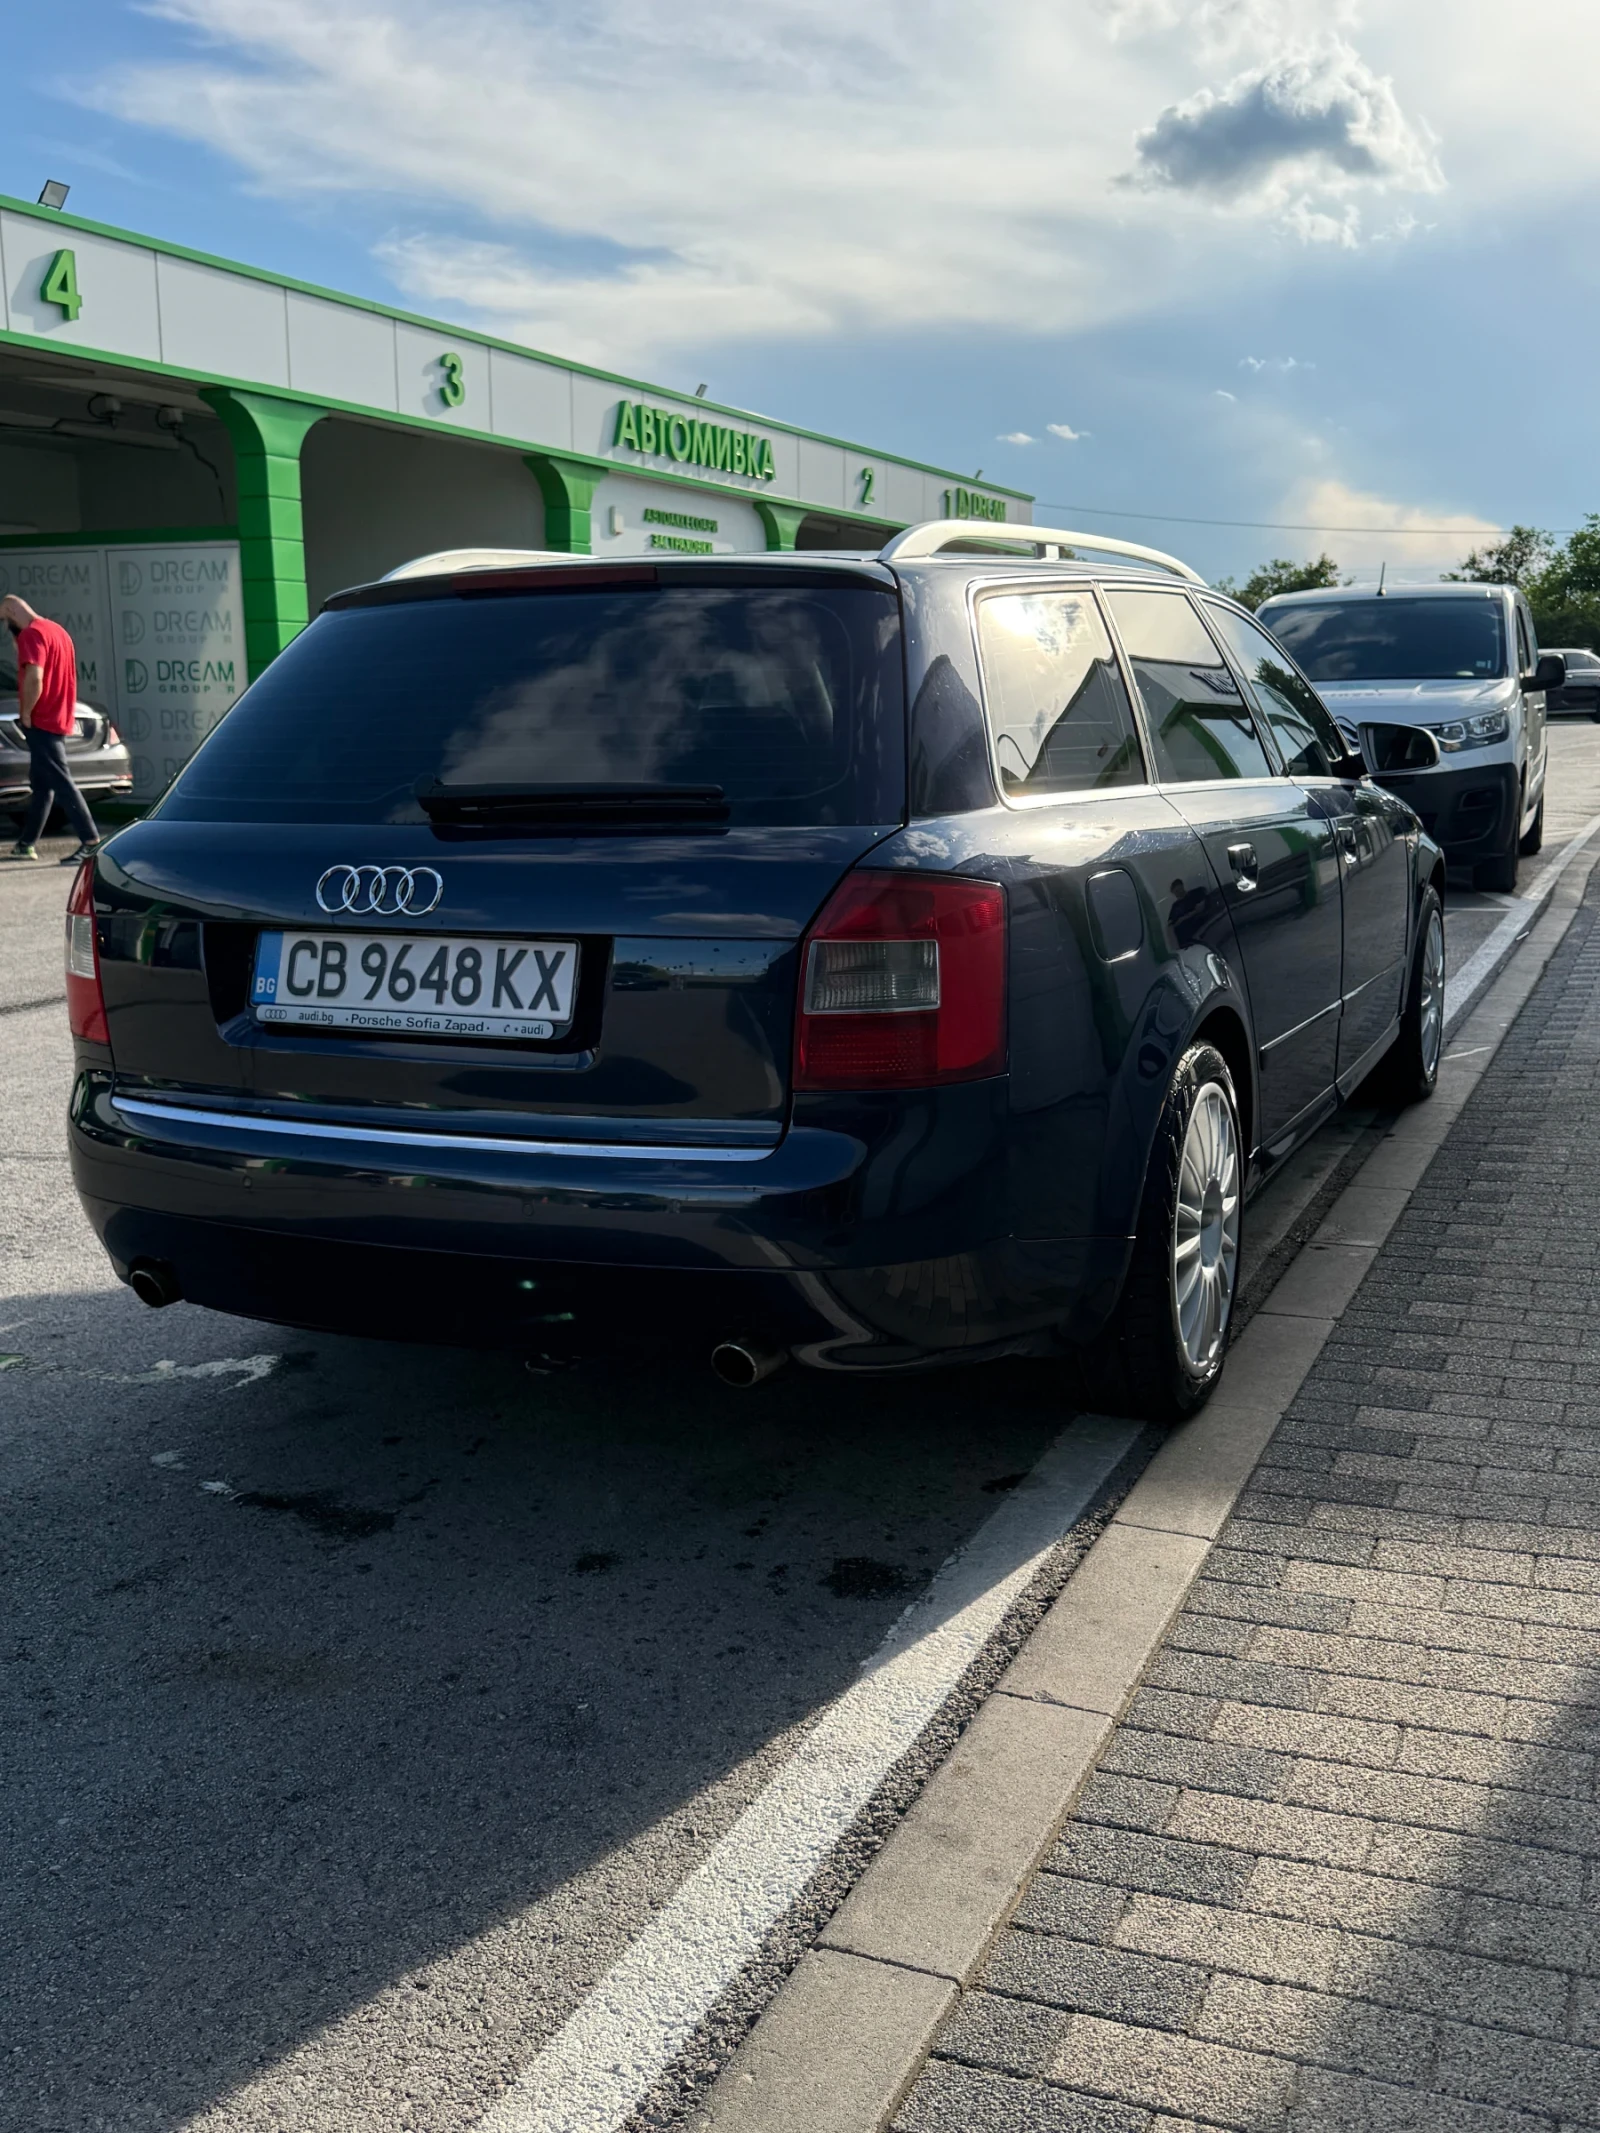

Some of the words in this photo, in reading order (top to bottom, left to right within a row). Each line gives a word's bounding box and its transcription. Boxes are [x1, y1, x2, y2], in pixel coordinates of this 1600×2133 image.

[40, 249, 83, 321] 4
[439, 352, 466, 407] 3
[613, 400, 776, 482] АВТОМИВКА
[862, 467, 875, 504] 2
[18, 564, 91, 586] DREAM
[150, 560, 229, 583] DREAM
[153, 610, 232, 632] DREAM
[156, 660, 235, 682] DREAM
[158, 684, 211, 694] GROUP
[160, 709, 225, 730] DREA
[256, 977, 276, 994] BG
[286, 940, 347, 998] CB
[361, 942, 482, 1006] 9648
[492, 948, 566, 1011] KX
[298, 1010, 334, 1024] audi.bg
[406, 1017, 440, 1029] Sofia
